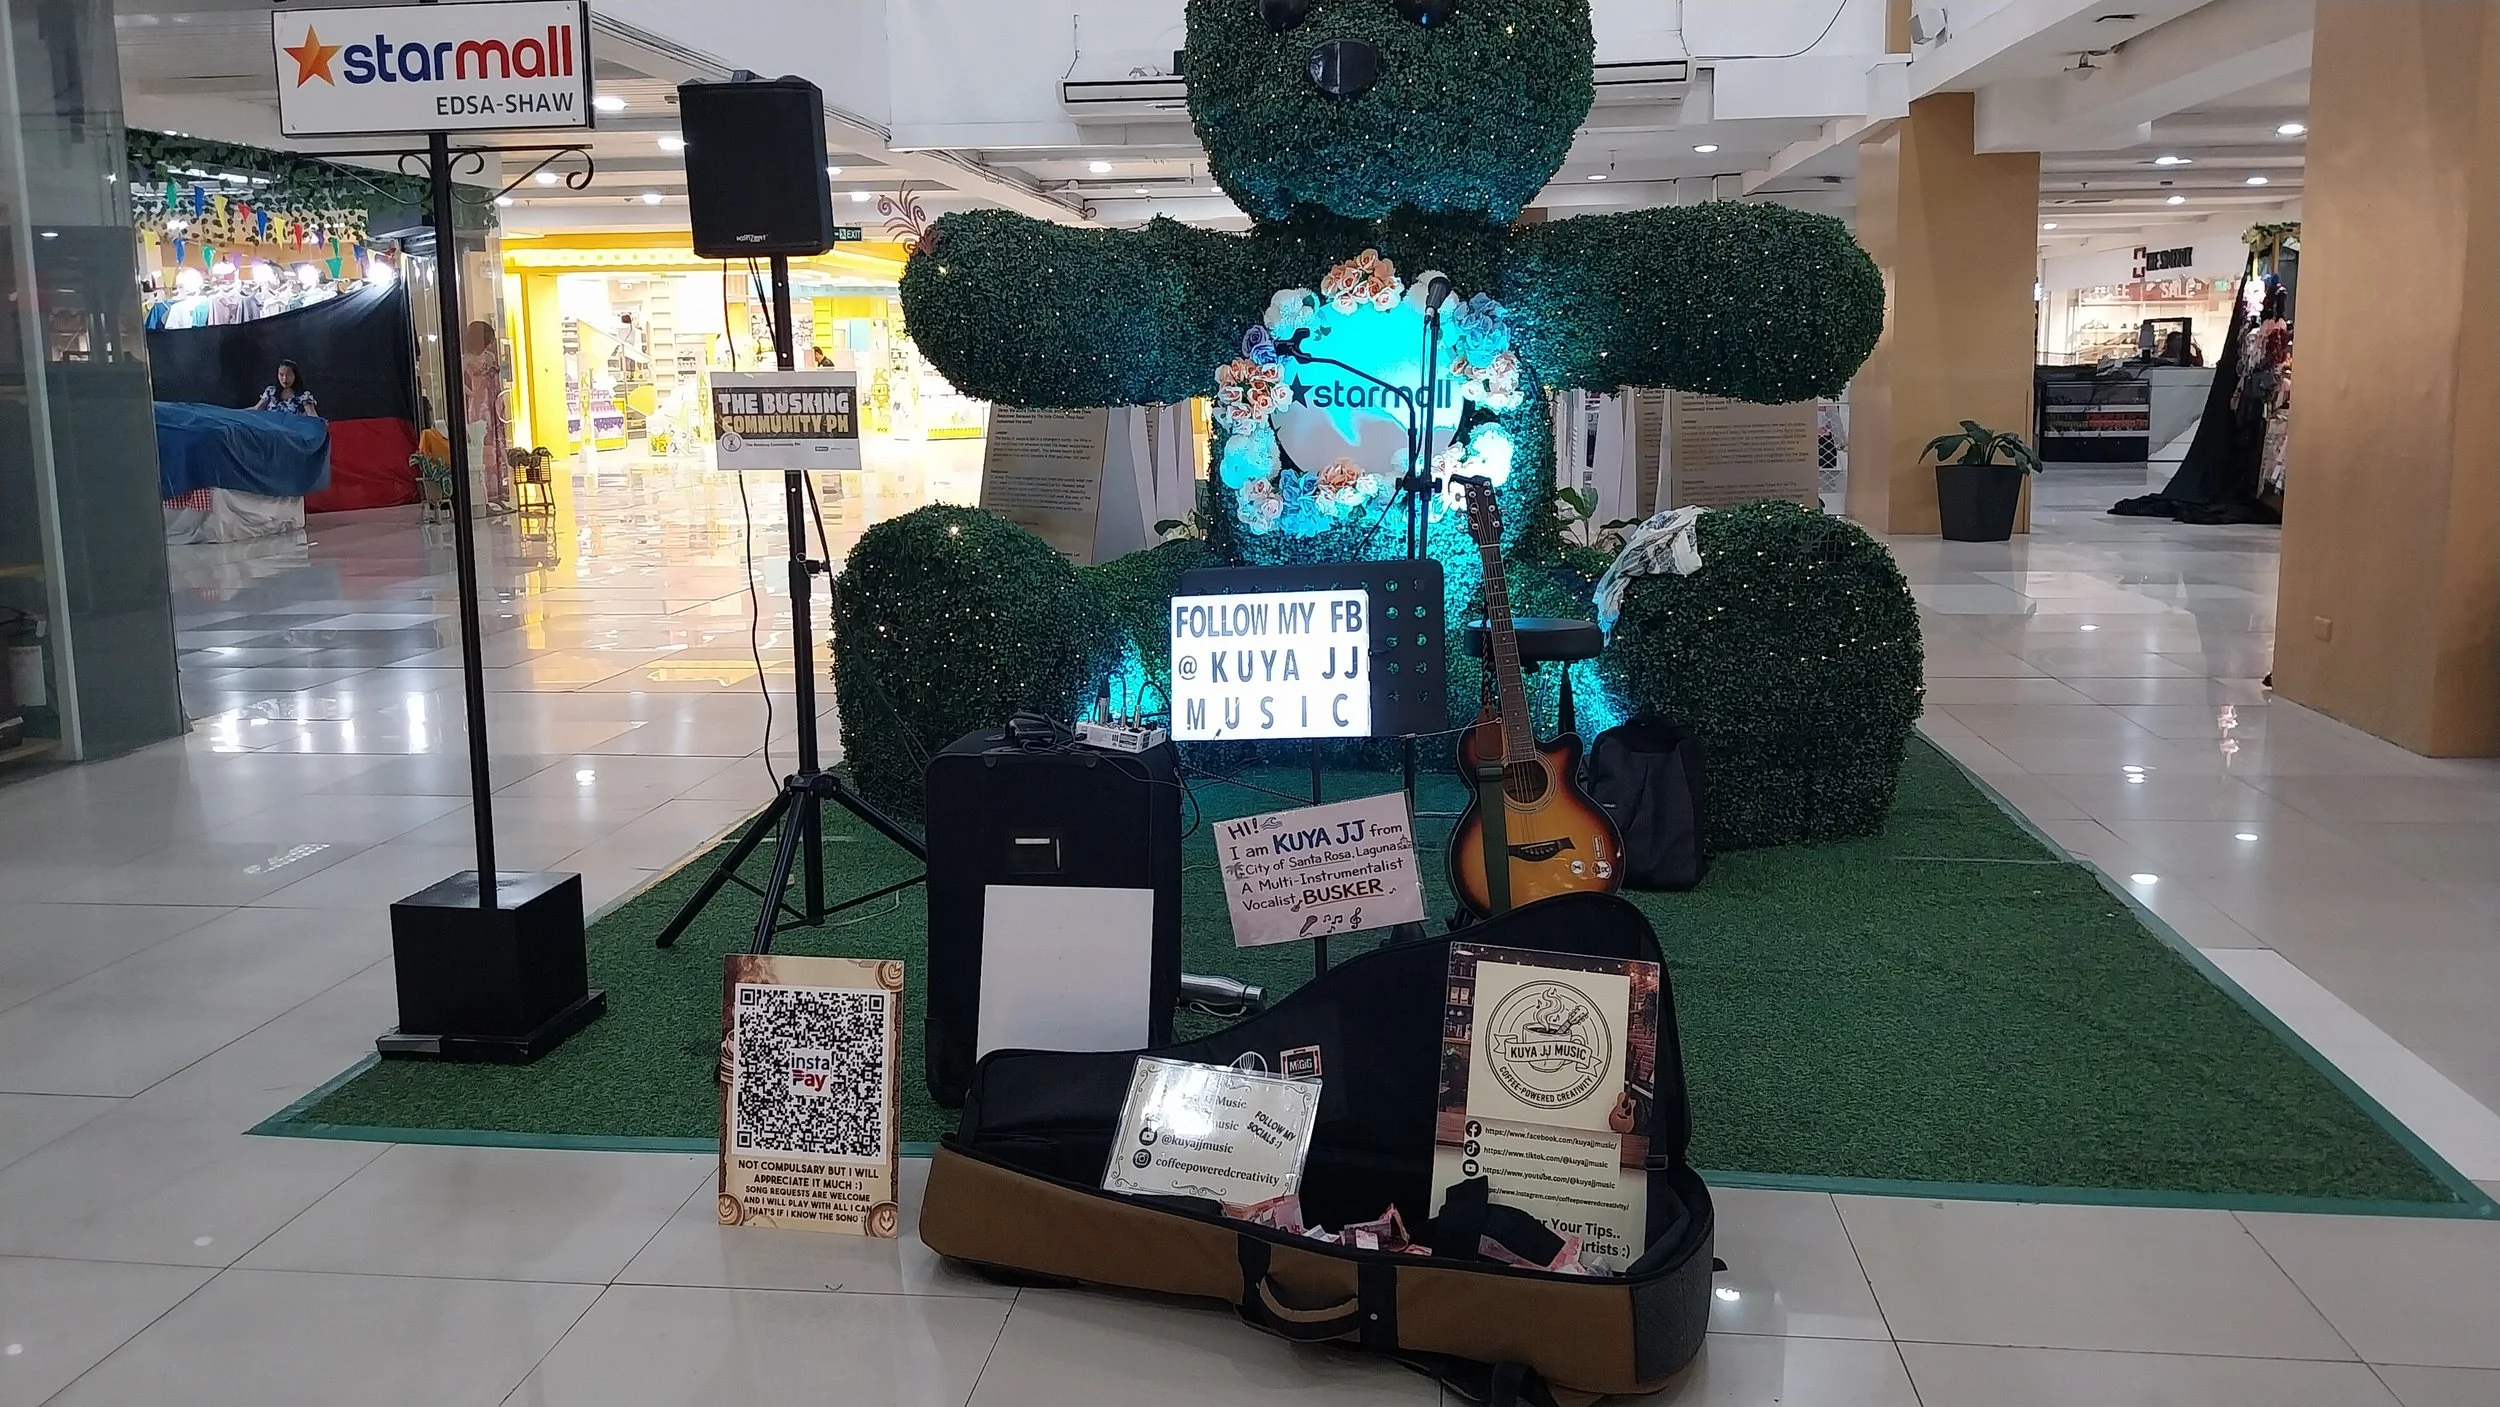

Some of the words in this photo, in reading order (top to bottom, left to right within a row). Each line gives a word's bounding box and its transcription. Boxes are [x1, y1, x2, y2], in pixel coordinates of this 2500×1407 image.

[343, 25, 573, 84] starmall
[436, 92, 574, 115] EDSA-SHAW
[846, 229, 861, 239] EXIT
[718, 393, 758, 414] THE
[762, 392, 849, 414] BUSKING
[1313, 379, 1450, 408] starmall
[721, 415, 822, 433] COMMUNITY
[826, 415, 849, 433] PH
[1176, 603, 1268, 638] FOLLOW
[1279, 602, 1316, 634] MY
[1331, 600, 1363, 633] FB
[1178, 655, 1198, 680] @
[1211, 649, 1300, 683] KUYA
[1322, 646, 1359, 680] JJ
[1187, 693, 1349, 730] MUSIC
[1227, 817, 1260, 840] HI!
[1230, 846, 1241, 861] I
[1245, 845, 1269, 858] am
[1273, 827, 1331, 855] KUYA
[1336, 819, 1366, 844] JJ
[1369, 823, 1403, 837] from
[1246, 863, 1271, 876] City
[1273, 859, 1286, 871] of
[1289, 853, 1323, 868] Santa
[1356, 842, 1396, 858] Laguna
[1241, 882, 1253, 895] A
[1259, 857, 1404, 892] Multi-Instrumentalist
[1302, 878, 1384, 905] BUSKER
[791, 1053, 831, 1071] insta
[1510, 1046, 1538, 1059] KUYA
[1540, 1044, 1552, 1057] JJ
[1554, 1043, 1587, 1061] MUSIC
[792, 1069, 829, 1092] Pay
[1499, 1066, 1555, 1103] COFFEE-POWERED
[1556, 1075, 1594, 1102] CREATIVITY
[1215, 1096, 1247, 1109] Music
[1247, 1121, 1277, 1146] SOCIALS
[1254, 1110, 1286, 1135] FOLLOW
[1282, 1128, 1297, 1142] MY
[1161, 1132, 1234, 1154] @kuyajjmusic
[1485, 1127, 1618, 1150] https://www.facebook.com/kuyajjmusic/
[1483, 1146, 1609, 1168] https://www.tiktok.com/@kuyajjmusic
[738, 1160, 758, 1170] NOT
[760, 1161, 825, 1175] COMPULSARY
[828, 1166, 847, 1177] BUT
[855, 1168, 879, 1179] WILL
[1155, 1157, 1281, 1187] coffeepoweredcreativity
[1482, 1166, 1616, 1189] https://www.youtube.com/@kuyajjmusic
[753, 1173, 809, 1187] APPRECIATE
[812, 1178, 820, 1188] IT
[823, 1179, 852, 1190] MUCH
[744, 1195, 761, 1205] AND
[766, 1197, 786, 1207] WILL
[788, 1199, 809, 1208] PLAY
[810, 1200, 831, 1210] WITH
[833, 1202, 848, 1211] ALL
[855, 1204, 872, 1213] CAN
[745, 1185, 768, 1194] SONG
[770, 1187, 810, 1198] REQUESTS
[812, 1190, 827, 1199] ARE
[829, 1191, 871, 1202] WELCOME
[1488, 1187, 1630, 1211] ps://www.instagram.com/coffeepoweredcreativity/
[748, 1206, 775, 1216] THAT'S
[776, 1208, 784, 1217] IF
[791, 1209, 817, 1220] KNOW
[818, 1212, 833, 1221] THE
[835, 1213, 859, 1222] SONG
[1551, 1218, 1583, 1234] Your
[1621, 1244, 1631, 1259] :)
